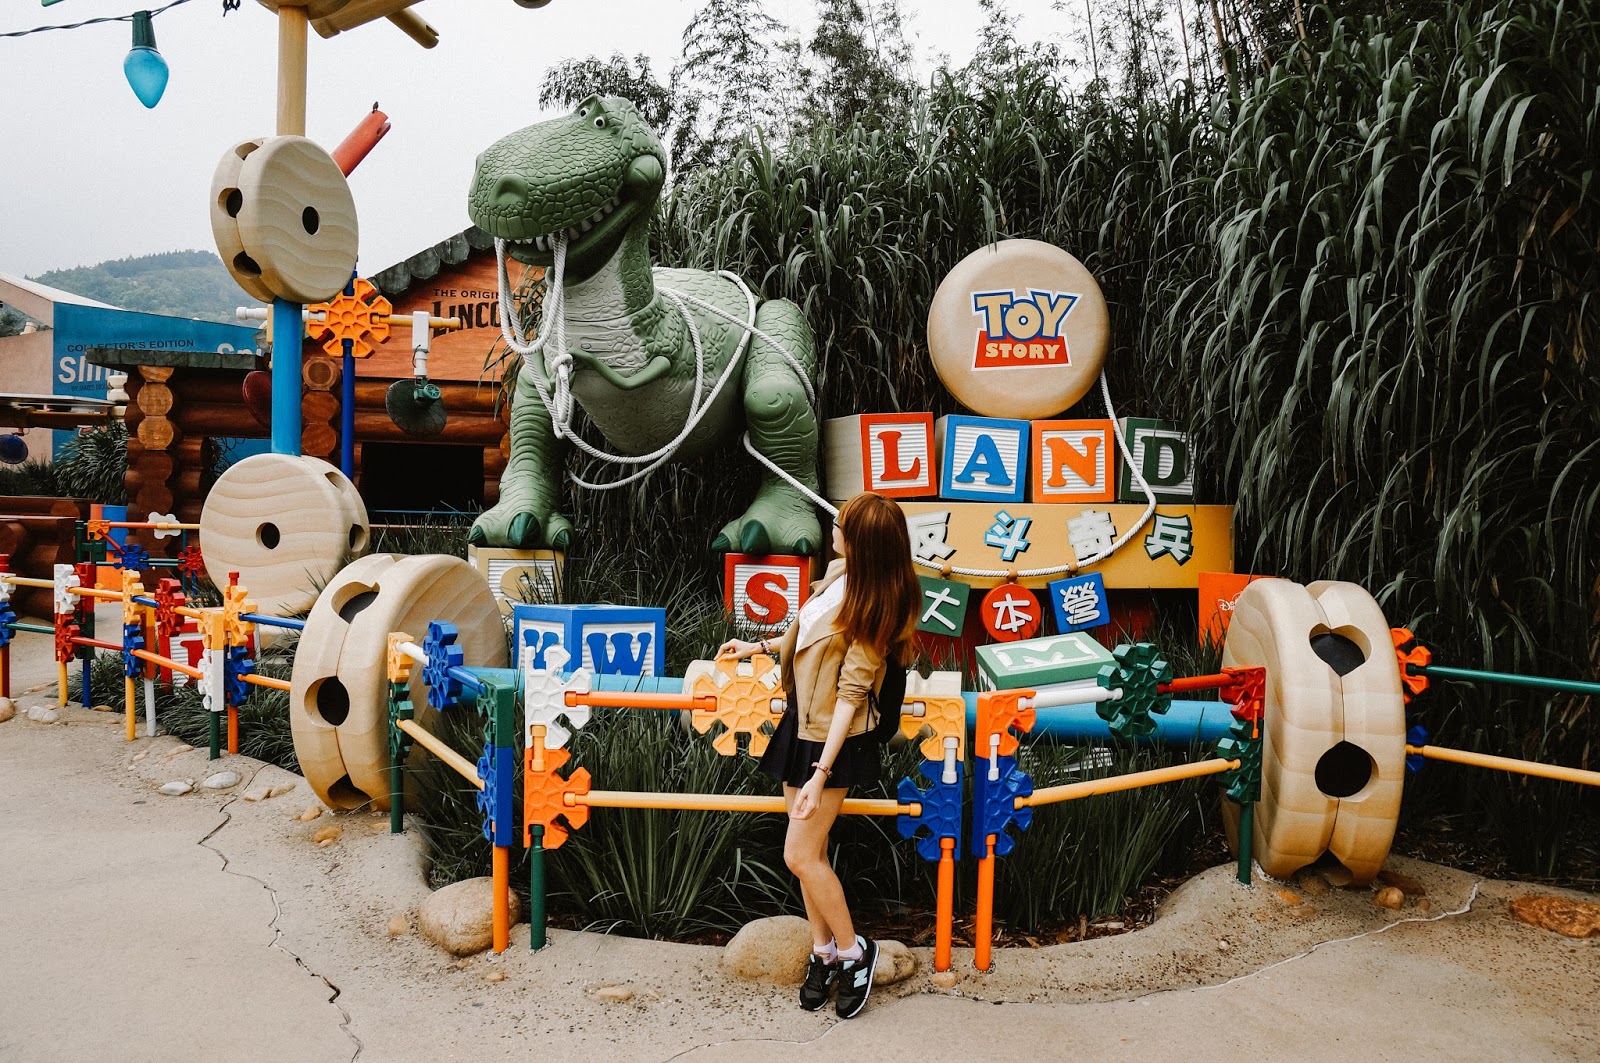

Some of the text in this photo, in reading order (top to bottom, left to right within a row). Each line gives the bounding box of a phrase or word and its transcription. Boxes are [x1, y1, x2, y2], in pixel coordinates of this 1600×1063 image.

[433, 288, 457, 298] THE
[432, 301, 535, 339] LINCO
[973, 289, 1079, 342] TOY
[149, 339, 194, 348] EDITION
[985, 342, 1060, 359] STORY
[876, 430, 1191, 487] LAND
[906, 509, 1195, 566] 反斗奇兵
[743, 571, 789, 625] S
[921, 581, 1101, 634] 大本營
[586, 632, 652, 676] W
[998, 640, 1094, 667] M
